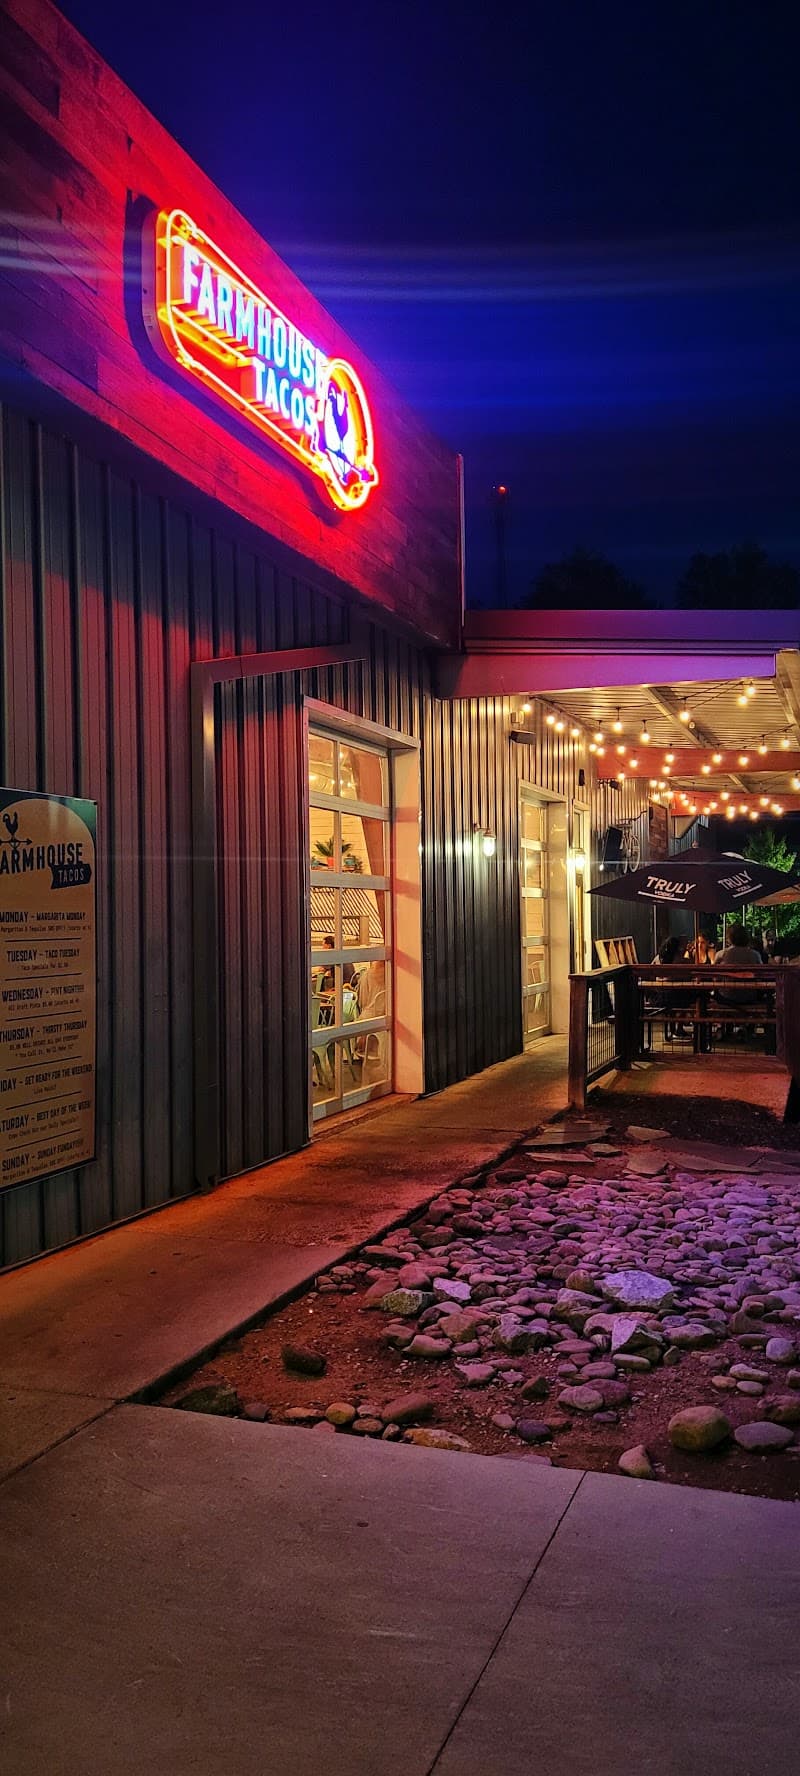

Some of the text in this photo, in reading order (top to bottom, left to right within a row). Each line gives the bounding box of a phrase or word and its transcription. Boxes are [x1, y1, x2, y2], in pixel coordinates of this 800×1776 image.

[183, 243, 329, 402] FARMHOUSE
[252, 356, 317, 434] TACOS
[0, 843, 83, 875] ARMHOUSE
[58, 868, 85, 882] TACOS
[646, 876, 696, 894] TRULY
[717, 870, 753, 890] TRULY
[0, 911, 29, 923] MONDAY
[36, 911, 65, 921] MARGARITA
[7, 949, 38, 963] TUESDAY
[45, 950, 58, 959] TACO
[59, 948, 80, 958] TUESDAY
[2, 986, 43, 1002] WEDNESDAY
[51, 986, 62, 996] PINT
[0, 1026, 34, 1043] THURSDAY
[43, 1023, 63, 1034] THIRSTY
[64, 1020, 87, 1031] THURSDAY
[0, 1078, 17, 1092] IDAY
[25, 1074, 35, 1086] GET
[36, 1071, 51, 1083] READY
[52, 1069, 61, 1080] FOR
[62, 1067, 71, 1077] THE
[0, 1114, 29, 1133] TURDAY
[37, 1110, 49, 1121] BEST
[50, 1107, 60, 1118] DAY
[61, 1105, 67, 1115] OF
[68, 1102, 77, 1113] THE
[2, 1152, 30, 1172] SUNDAY
[38, 1144, 57, 1160] SUNDAY
